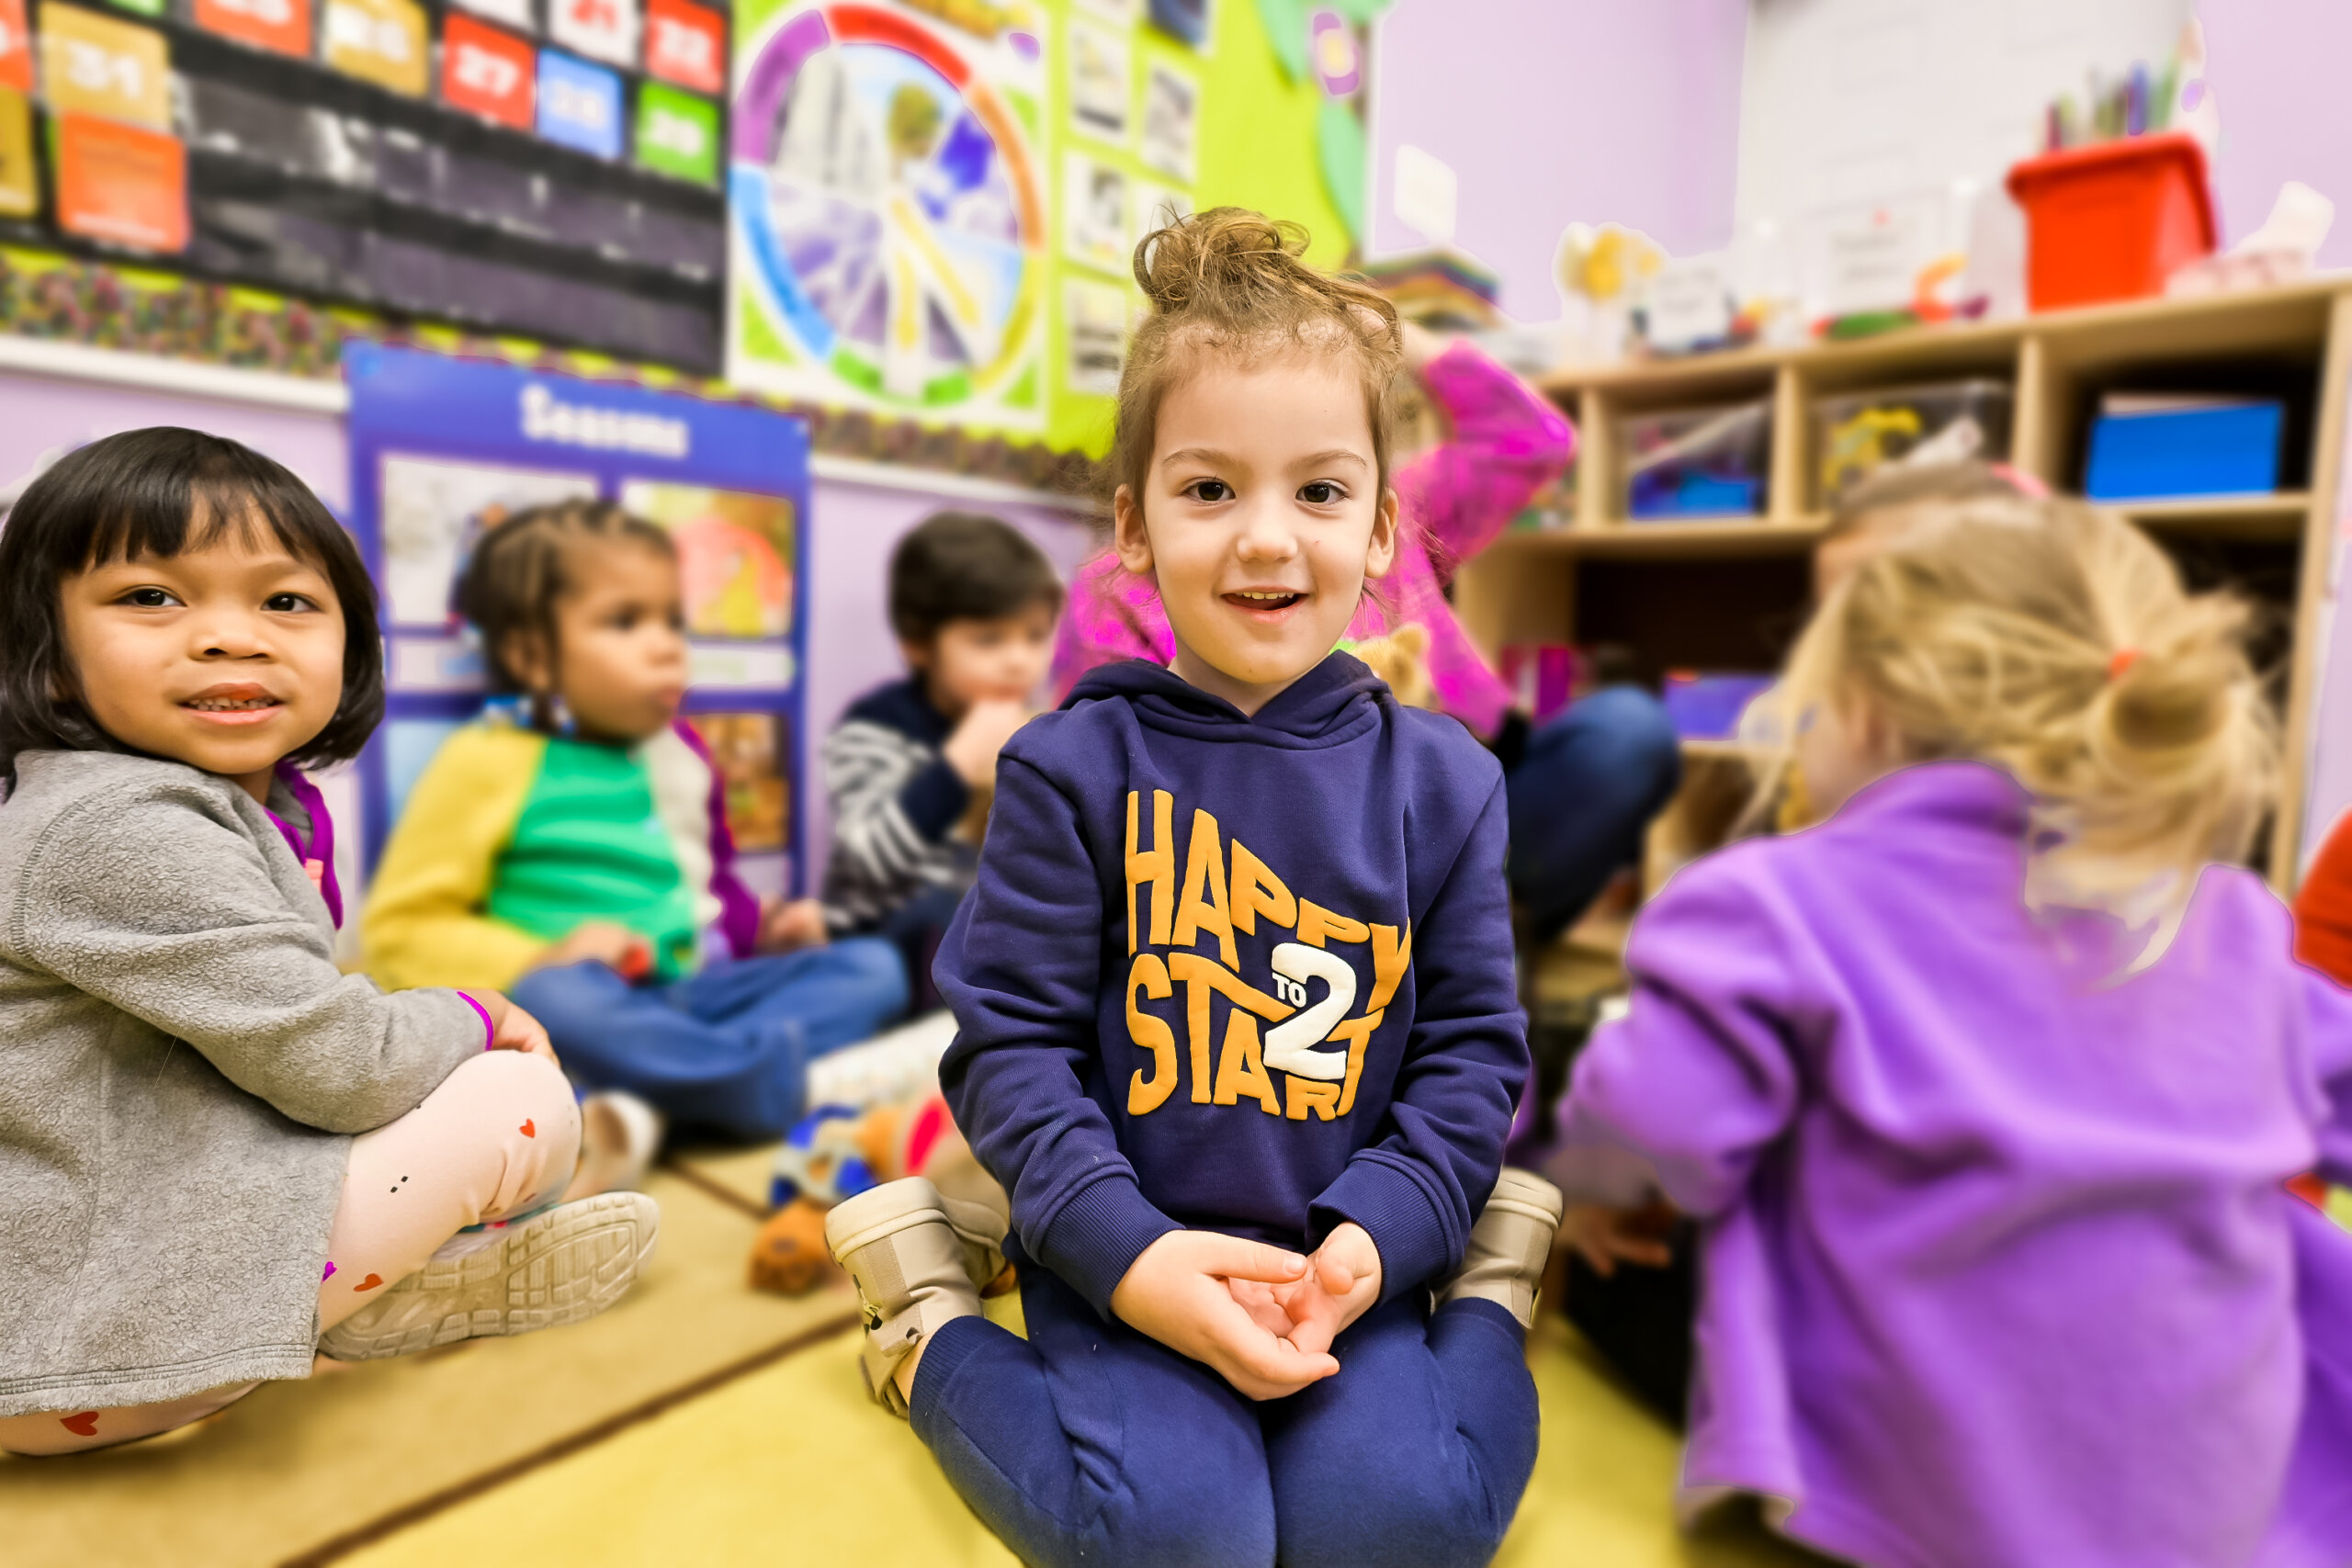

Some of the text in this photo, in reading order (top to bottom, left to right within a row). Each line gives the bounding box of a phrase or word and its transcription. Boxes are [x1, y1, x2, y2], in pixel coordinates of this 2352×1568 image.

[67, 41, 141, 99] 31
[457, 43, 519, 97] 27
[1125, 789, 1411, 1014] HAPPY
[1126, 953, 1384, 1121] START
[1263, 942, 1356, 1079] TO 2
